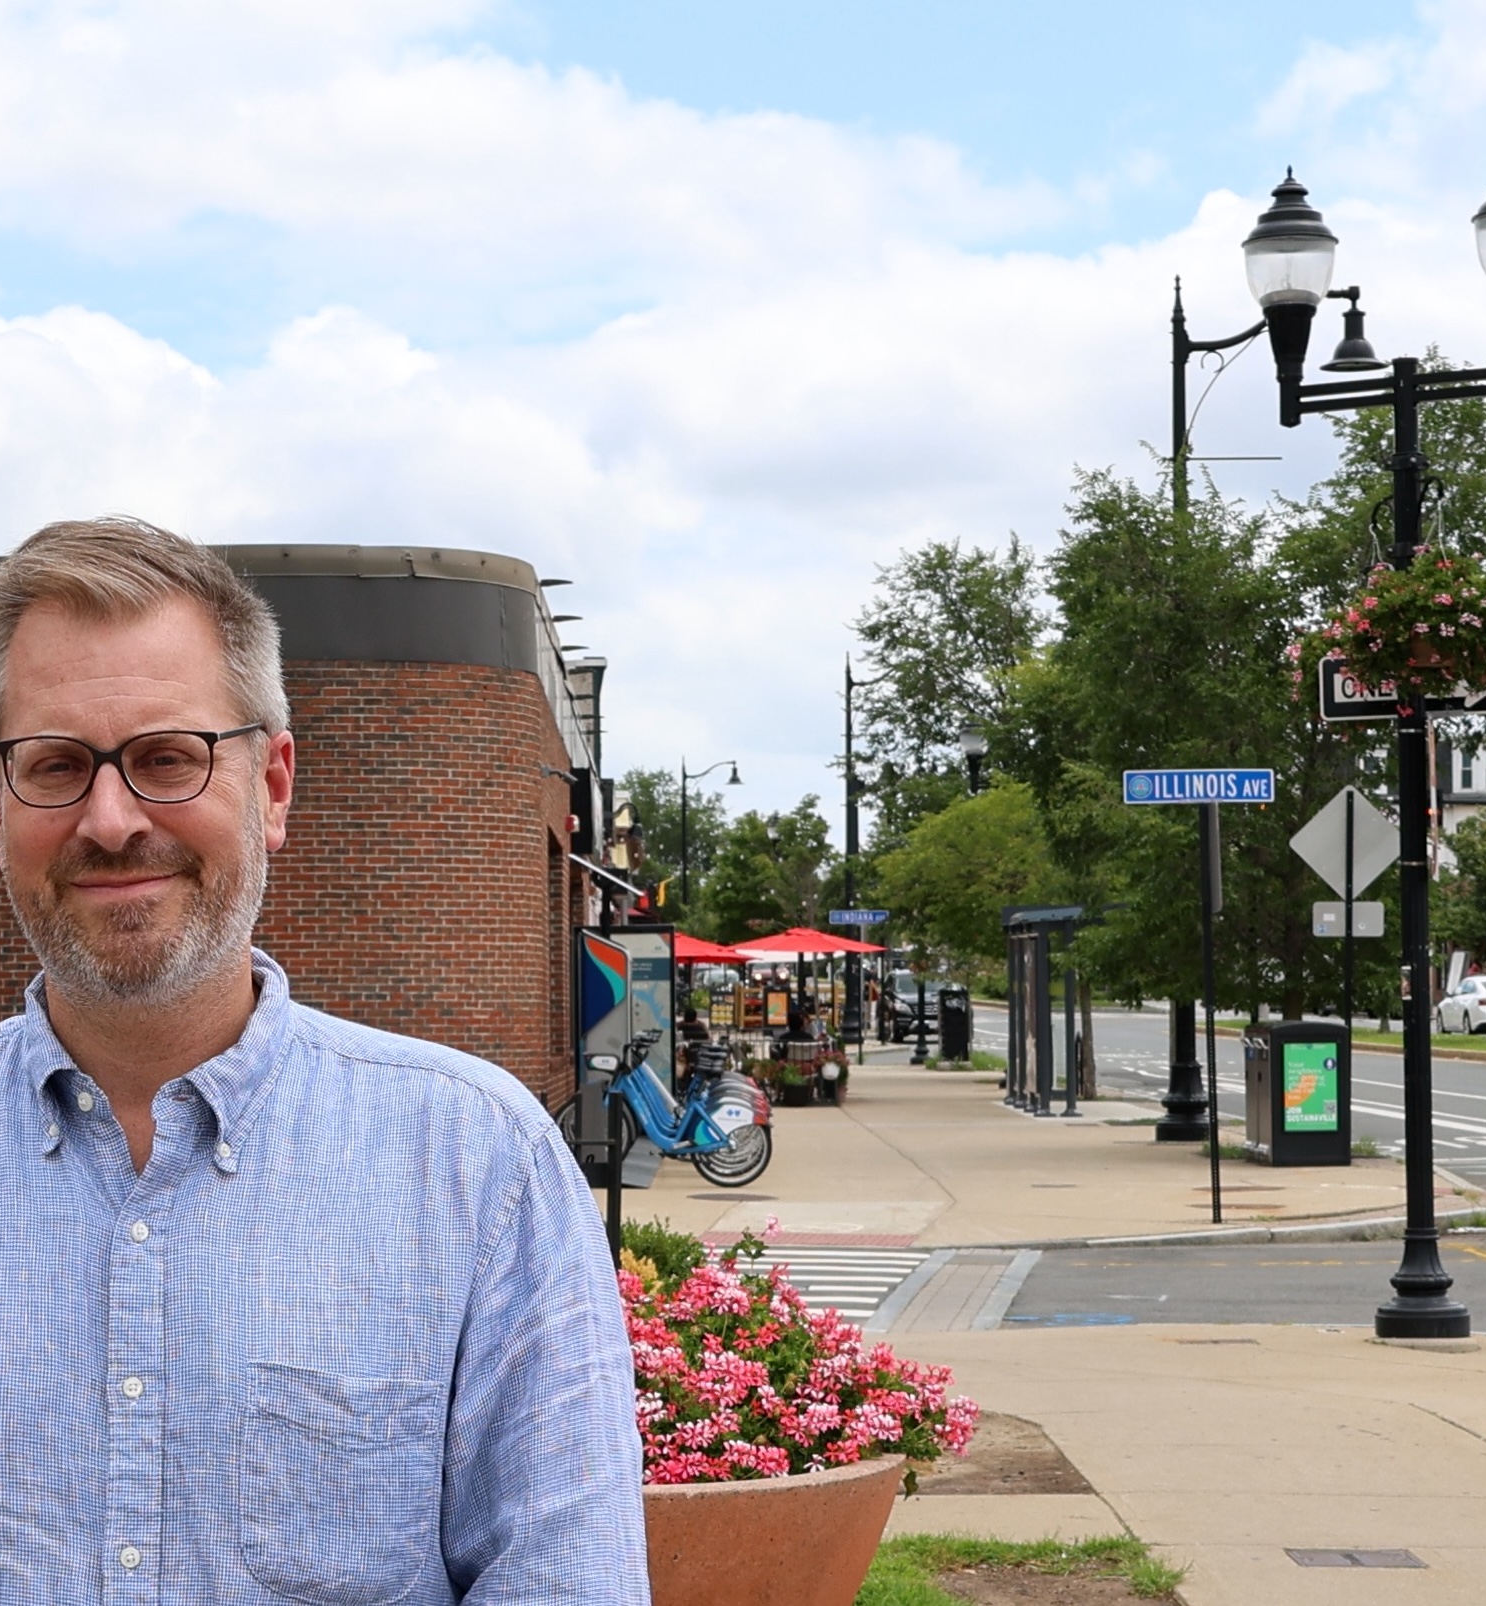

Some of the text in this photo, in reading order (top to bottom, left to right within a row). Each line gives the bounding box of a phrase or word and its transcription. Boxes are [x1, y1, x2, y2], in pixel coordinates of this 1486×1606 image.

[1154, 774, 1268, 799] ILLINOIS AVE
[841, 912, 874, 921] INDIANA
